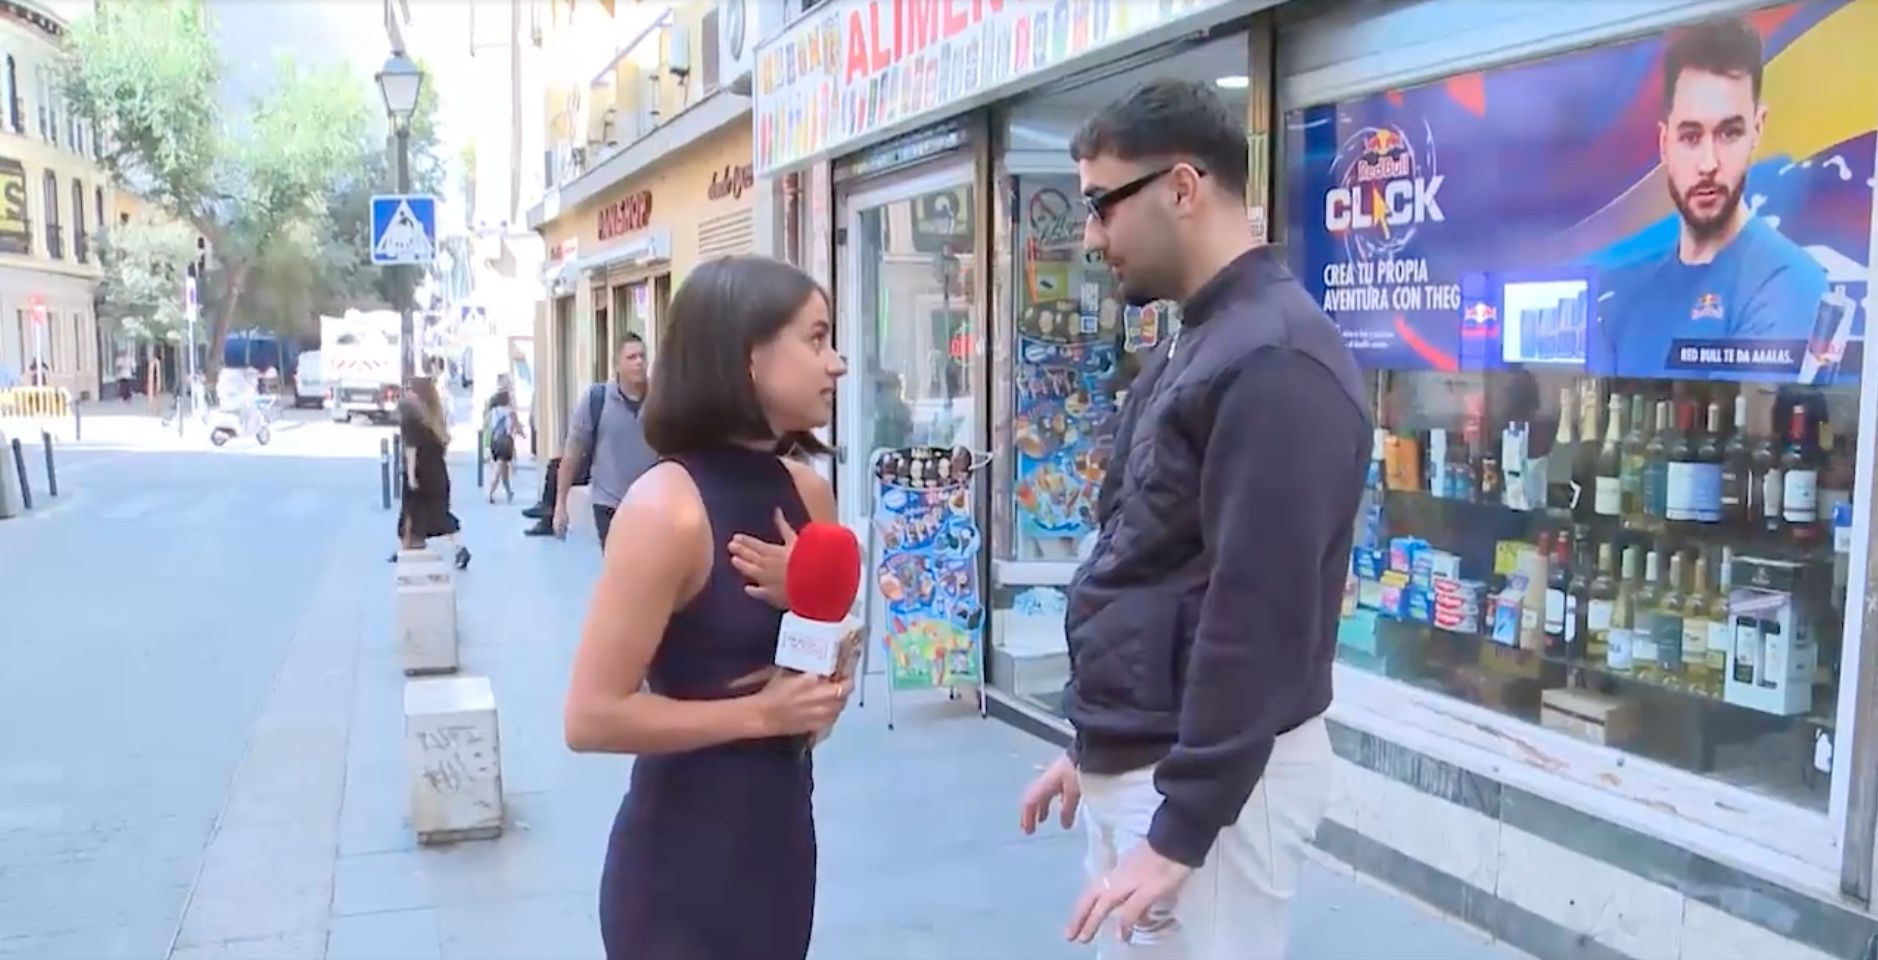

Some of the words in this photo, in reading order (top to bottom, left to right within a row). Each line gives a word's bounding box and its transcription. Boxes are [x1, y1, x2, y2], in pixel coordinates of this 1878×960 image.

[846, 0, 1004, 87] ALIME
[1323, 262, 1354, 286] CREA
[1357, 261, 1374, 284] TU
[1377, 257, 1429, 284] PROPIA
[1323, 286, 1389, 311] AVENTURA
[1392, 285, 1421, 311] CON
[1723, 348, 1734, 363] TE
